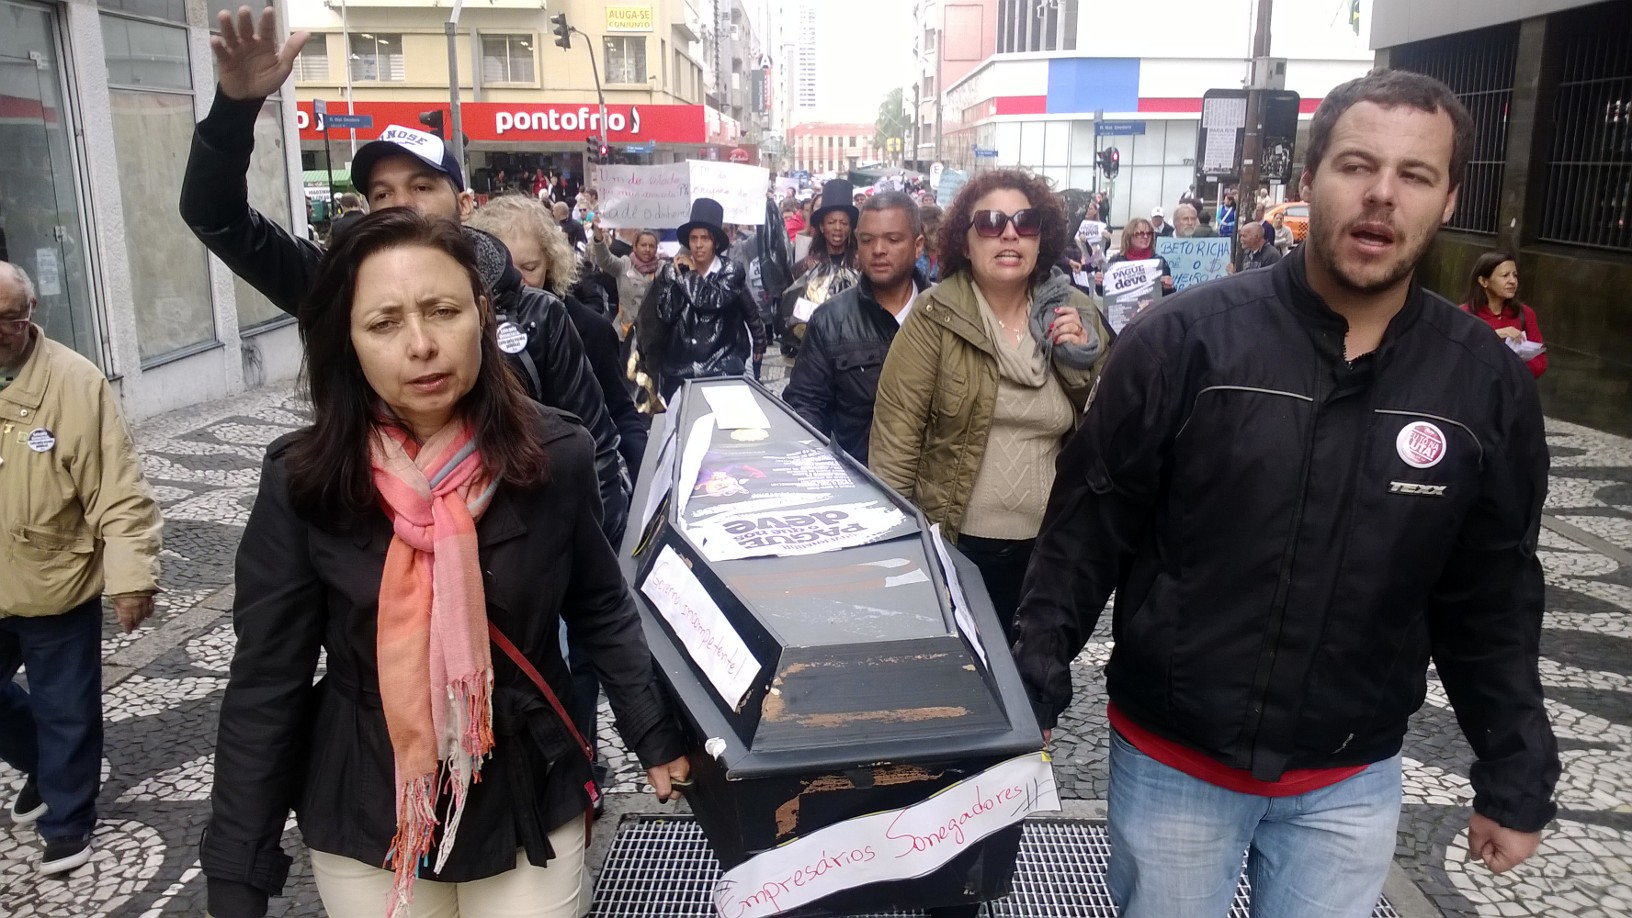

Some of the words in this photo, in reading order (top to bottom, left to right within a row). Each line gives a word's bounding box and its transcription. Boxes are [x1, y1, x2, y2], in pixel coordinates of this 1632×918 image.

[609, 10, 650, 19] ALUGA-SE
[496, 107, 626, 134] pontofrio
[934, 165, 940, 174] E
[1160, 240, 1194, 255] BETO
[1196, 241, 1230, 257] RICHA
[1112, 264, 1144, 280] PAGUE
[1115, 275, 1147, 290] deve
[722, 510, 849, 534] deve
[770, 526, 801, 534] que
[733, 529, 767, 541] nos
[738, 523, 867, 549] PAGUE
[718, 846, 876, 918] Empresários
[885, 785, 1022, 858] Sonegadores
